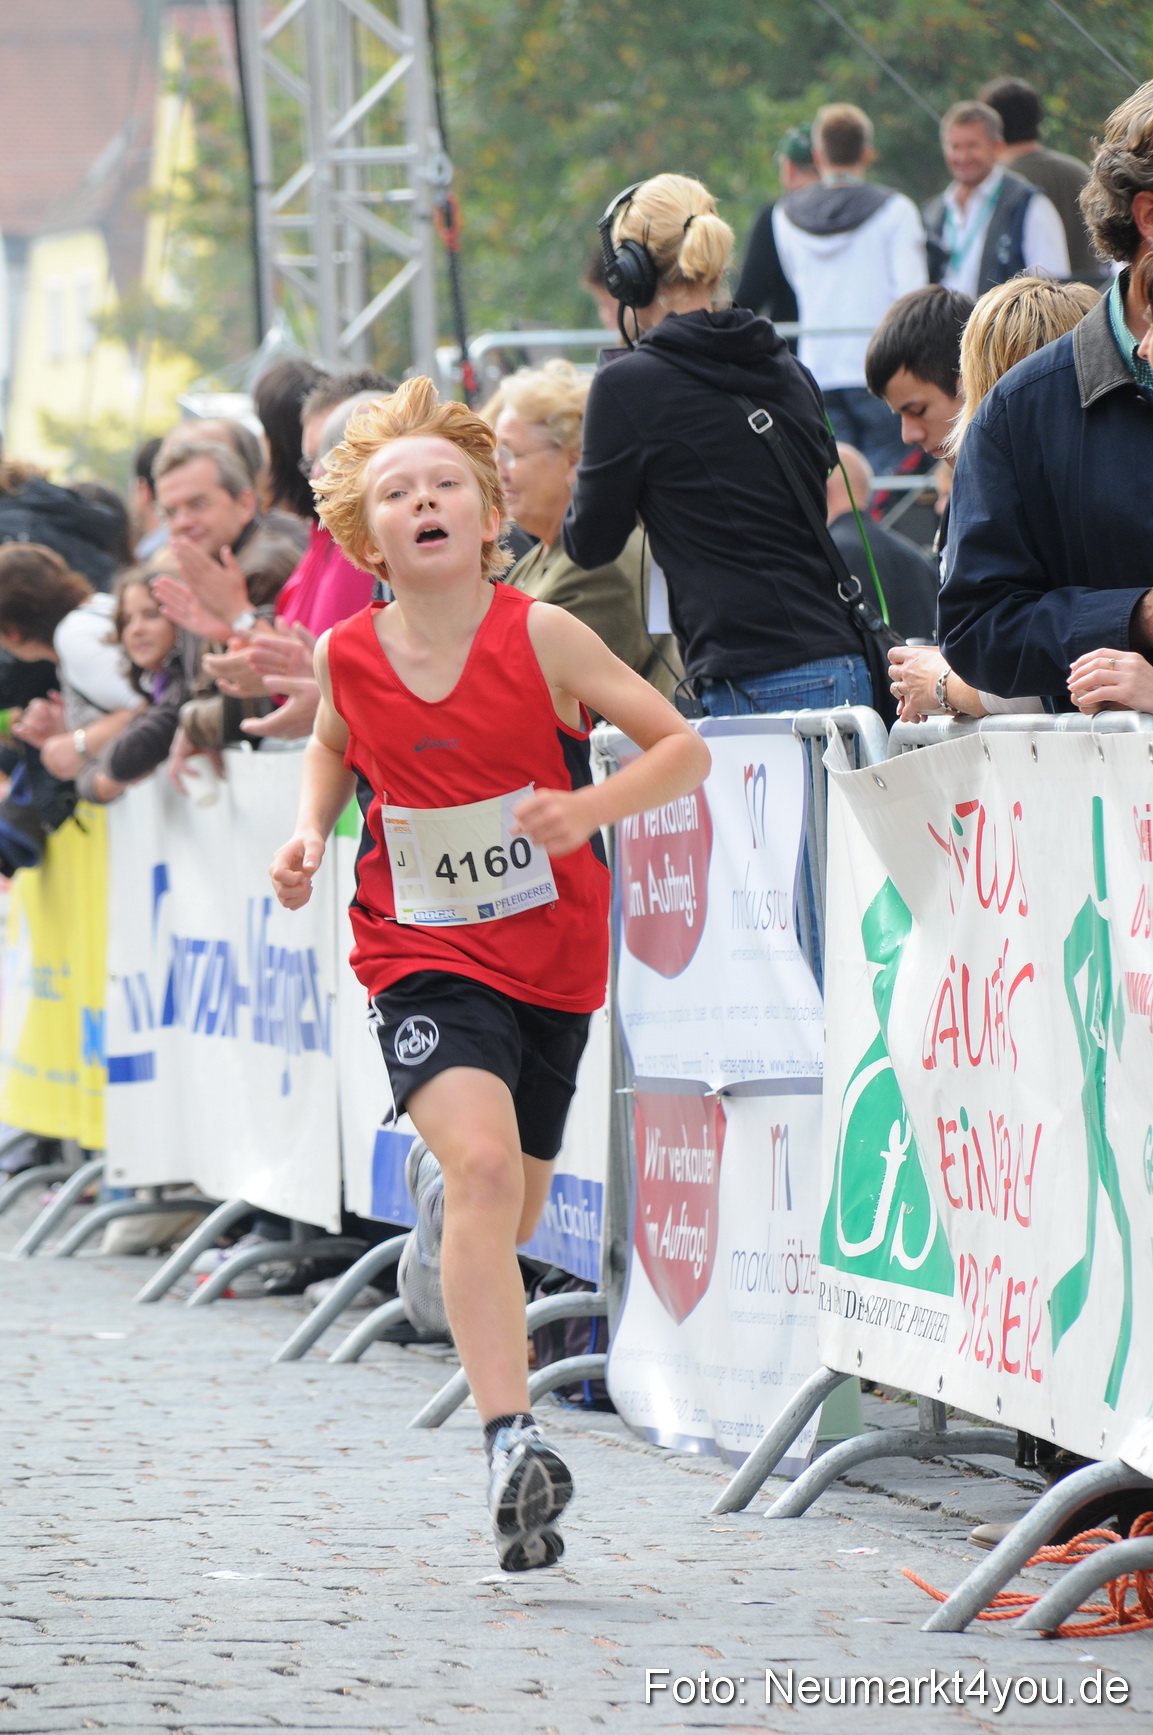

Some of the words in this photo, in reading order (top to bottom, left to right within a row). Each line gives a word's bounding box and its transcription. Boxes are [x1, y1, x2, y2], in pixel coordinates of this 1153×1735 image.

[396, 850, 406, 867] J
[435, 837, 532, 885] 4160
[495, 882, 553, 910] PFLEIDERER
[628, 867, 646, 918] im
[649, 853, 698, 928] Auftrag!
[644, 1126, 667, 1182] Wir
[658, 1201, 710, 1281] Auftrag!
